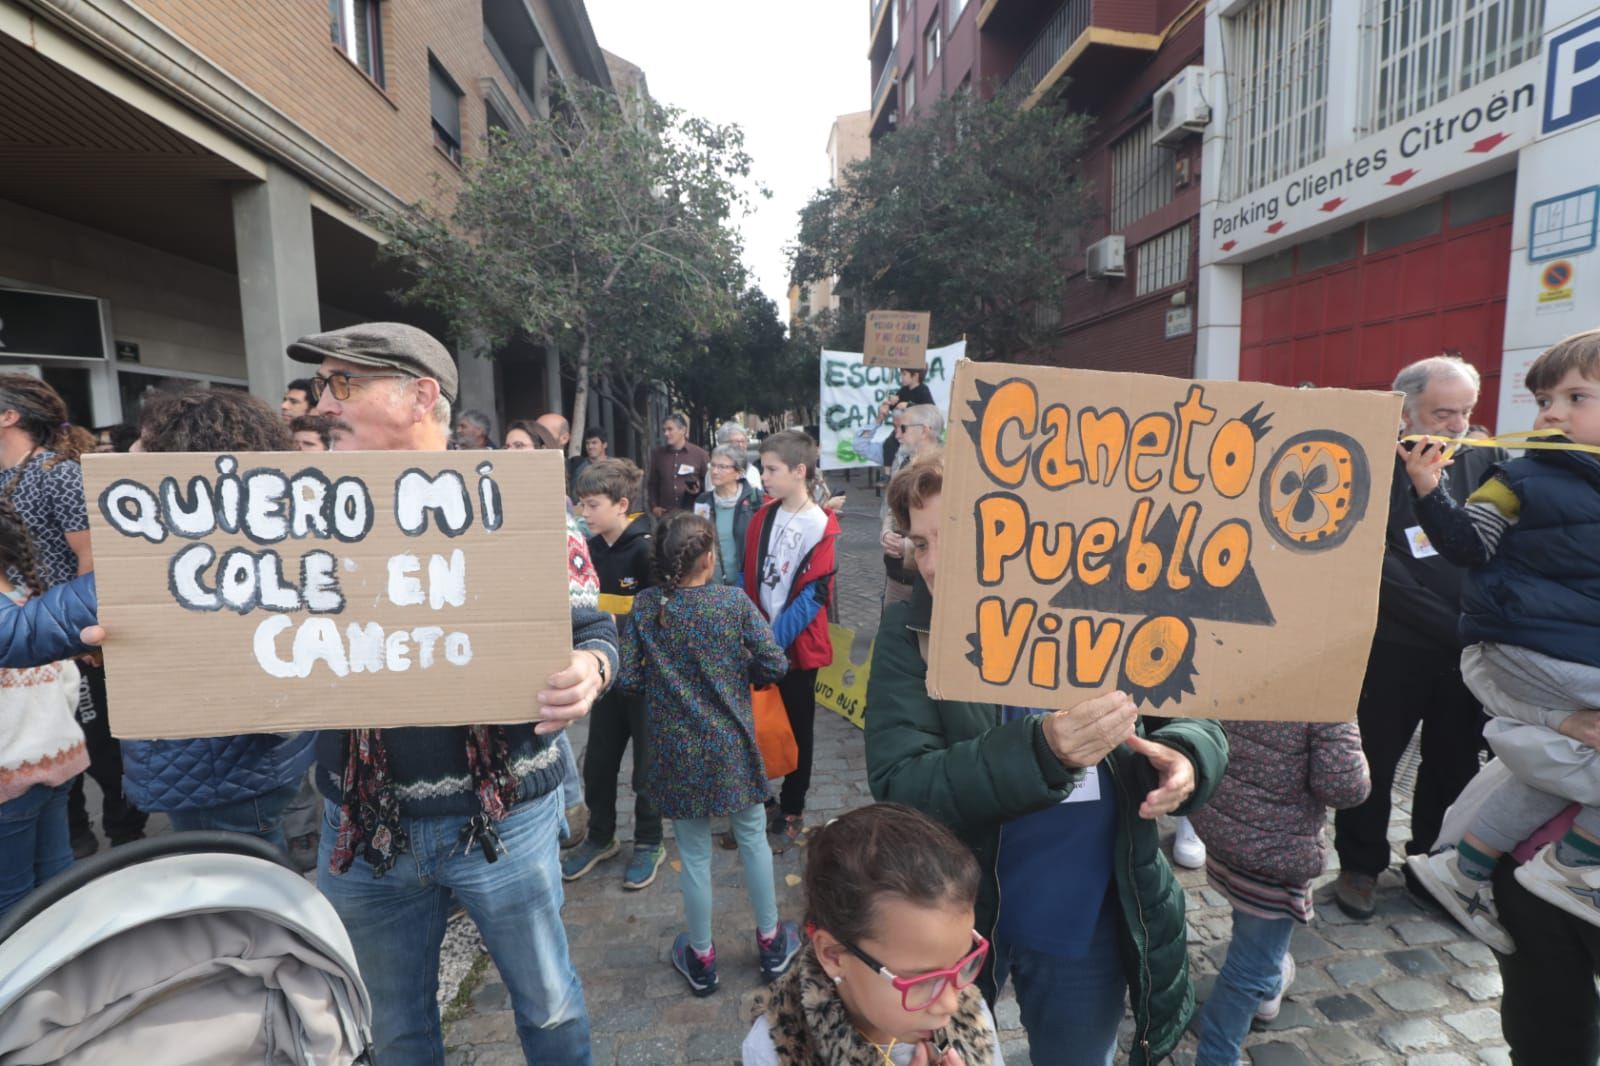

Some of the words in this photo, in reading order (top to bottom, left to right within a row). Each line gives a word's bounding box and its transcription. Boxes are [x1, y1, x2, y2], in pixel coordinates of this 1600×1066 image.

[1551, 26, 1600, 120] P
[1213, 198, 1279, 239] Parking
[1286, 148, 1388, 207] Clientes
[1400, 82, 1535, 159] Citroën
[976, 377, 1262, 499] Caneto
[168, 543, 346, 615] COLE
[388, 548, 467, 610] EN
[974, 491, 1252, 593] Pueblo
[253, 614, 473, 678] CANETO
